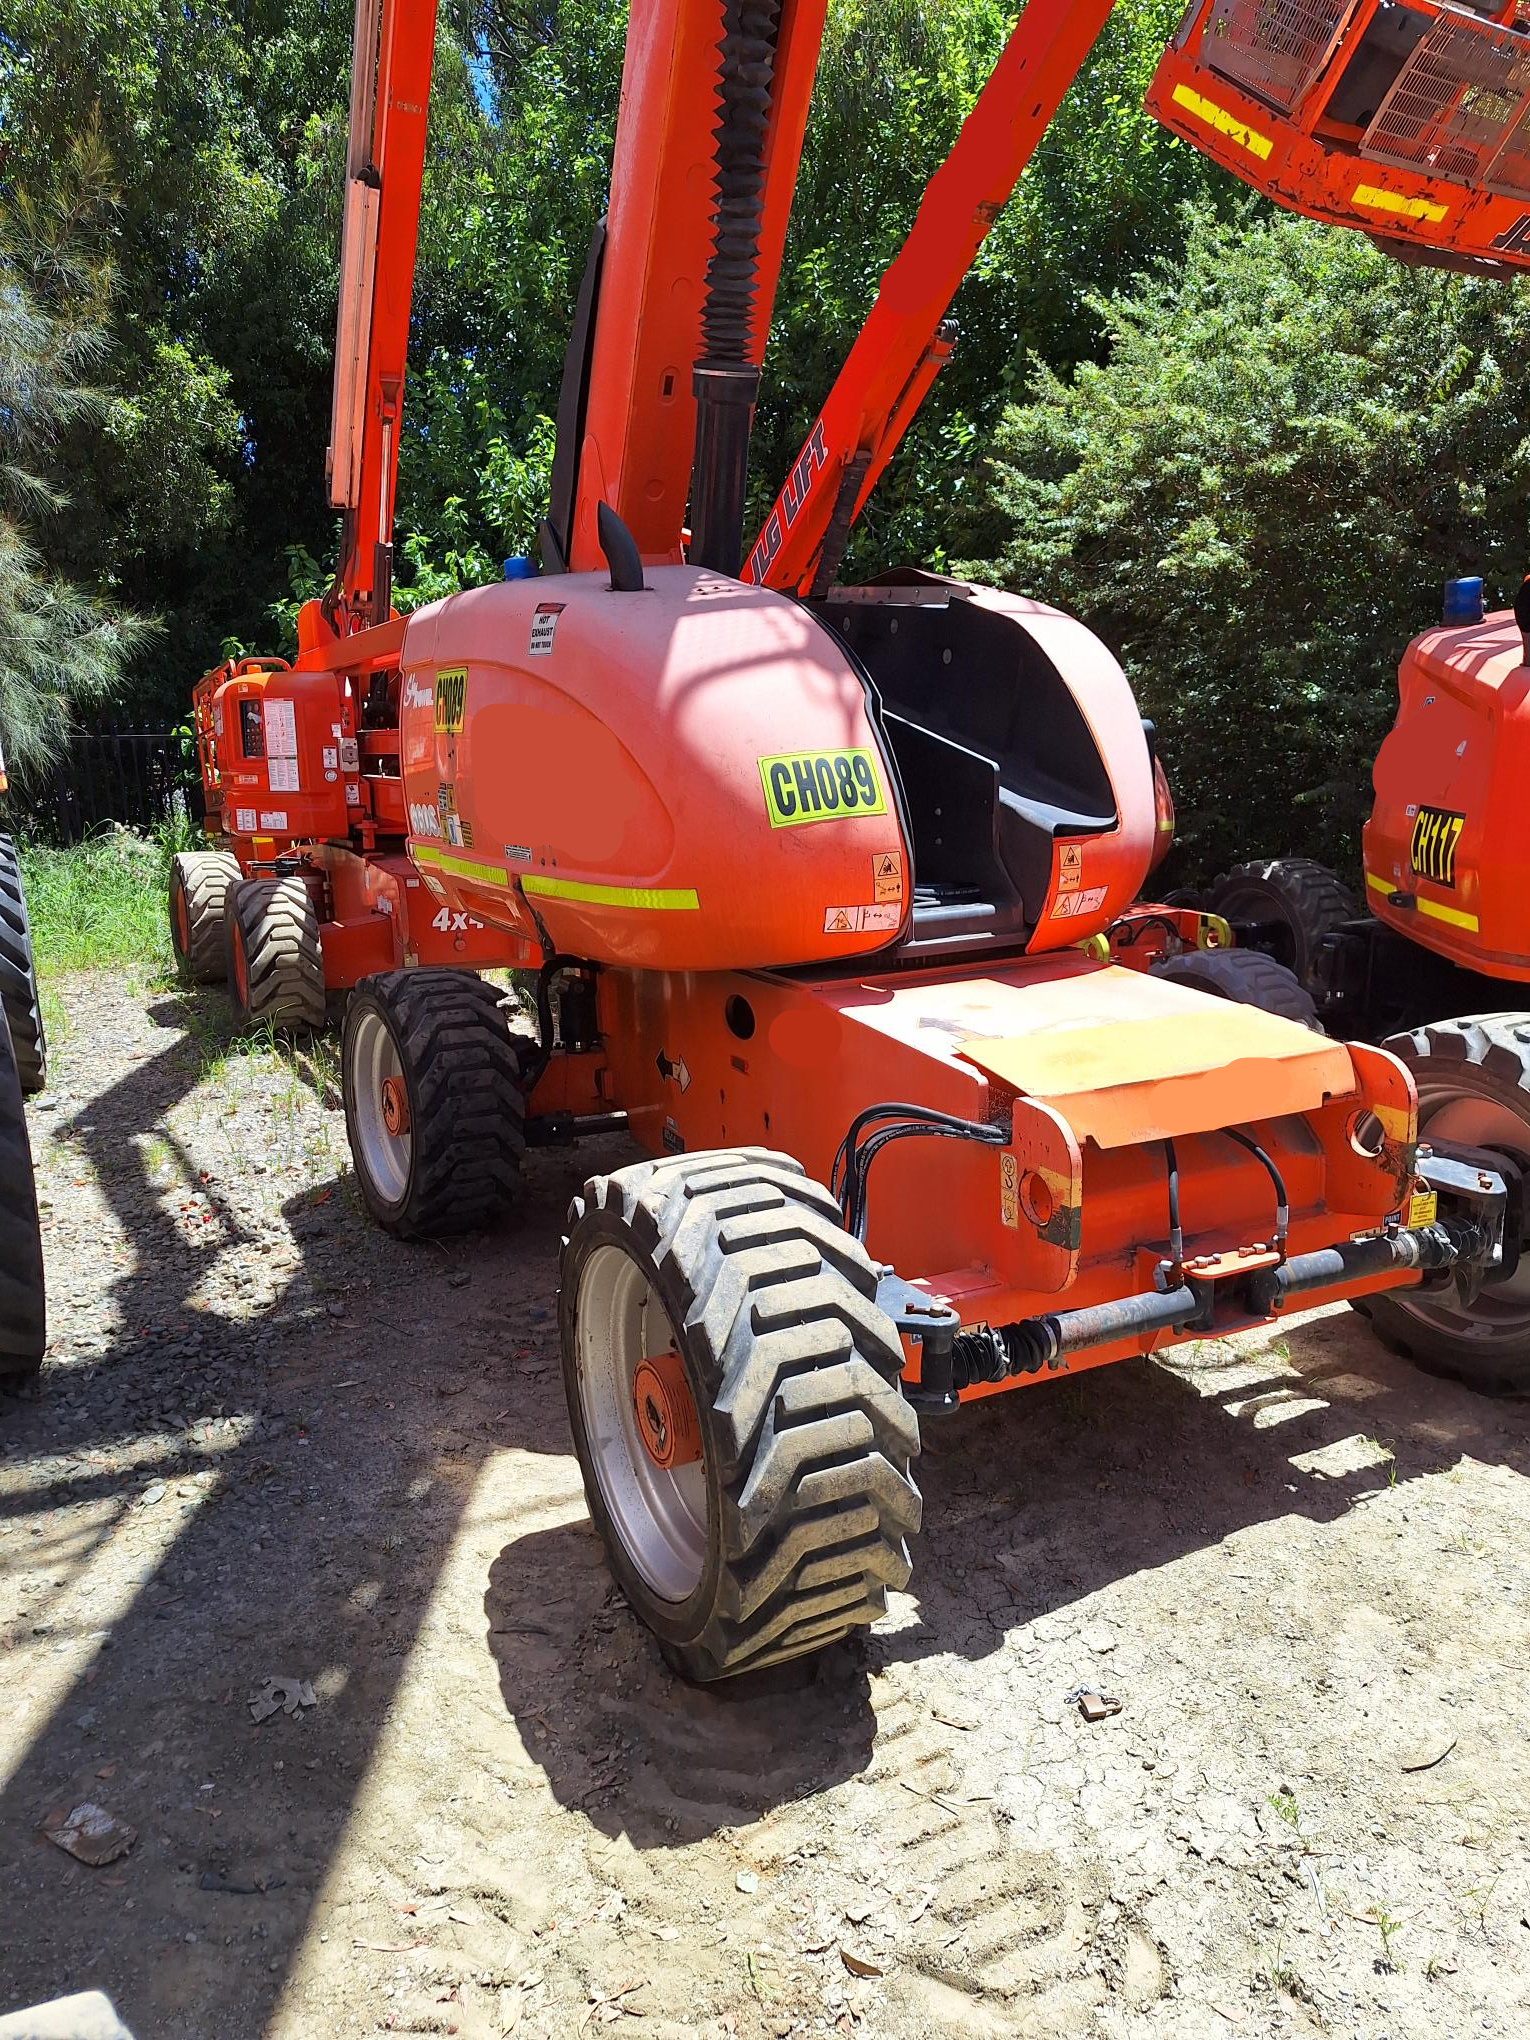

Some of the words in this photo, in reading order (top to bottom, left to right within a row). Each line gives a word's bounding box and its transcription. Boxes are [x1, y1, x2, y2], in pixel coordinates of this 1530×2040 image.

[1488, 213, 1530, 255] JL
[750, 509, 783, 586] JLG
[782, 419, 826, 529] LIFT
[532, 627, 553, 637] EXHAUST
[539, 616, 550, 624] HOT
[436, 675, 464, 726] CH089
[770, 754, 877, 817] CH089
[1410, 810, 1464, 883] CH117
[1384, 1213, 1401, 1224] POINT
